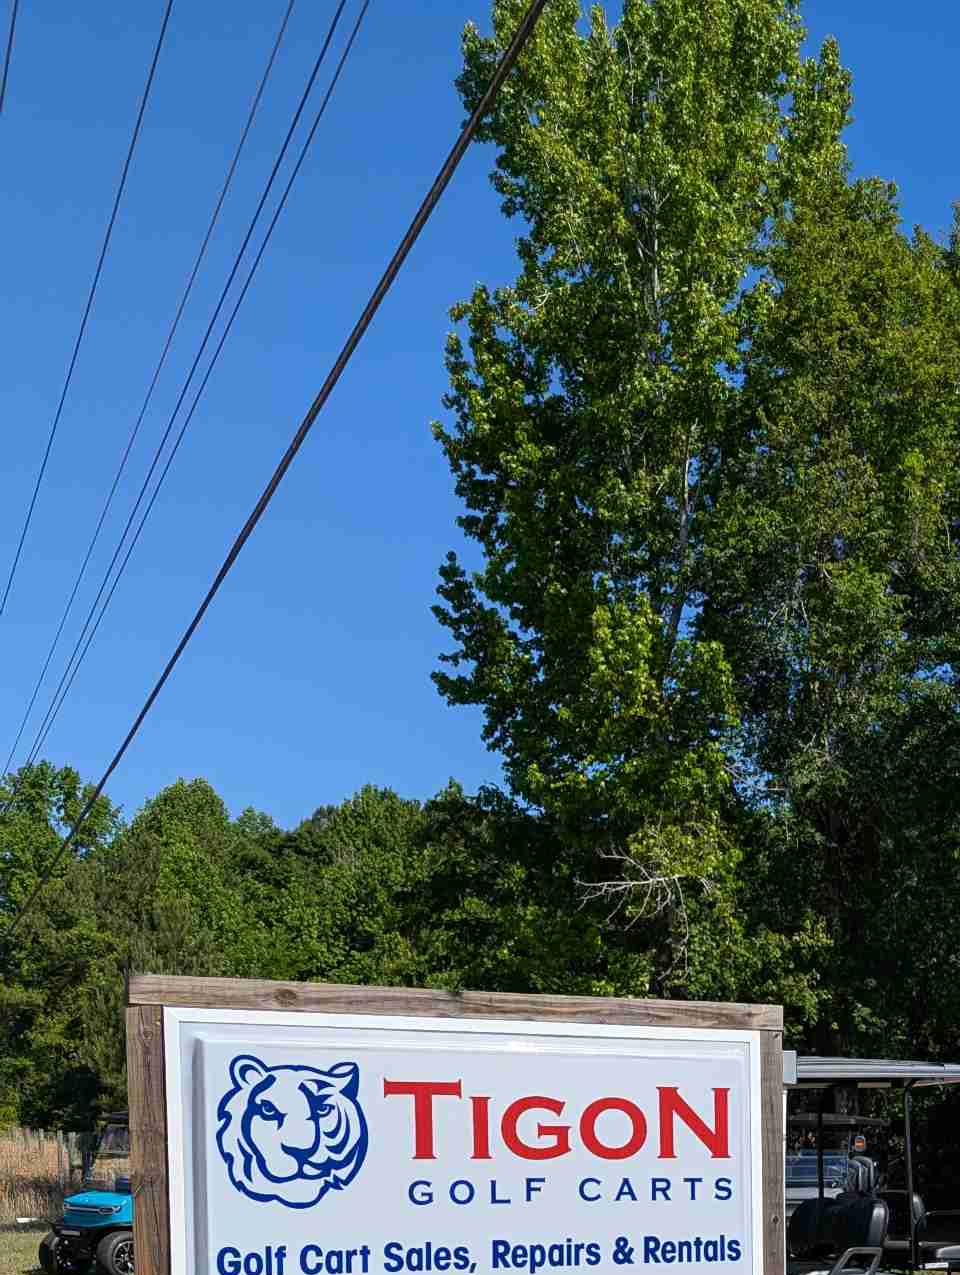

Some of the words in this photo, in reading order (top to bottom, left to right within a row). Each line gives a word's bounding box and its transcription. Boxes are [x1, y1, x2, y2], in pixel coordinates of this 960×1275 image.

[408, 1176, 546, 1206] GOLF
[578, 1176, 734, 1202] CARTS
[298, 1242, 371, 1275] Cart
[383, 1240, 477, 1274] Sales,
[491, 1237, 602, 1275] Repairs
[612, 1235, 635, 1266] &
[642, 1234, 742, 1265] Rentals
